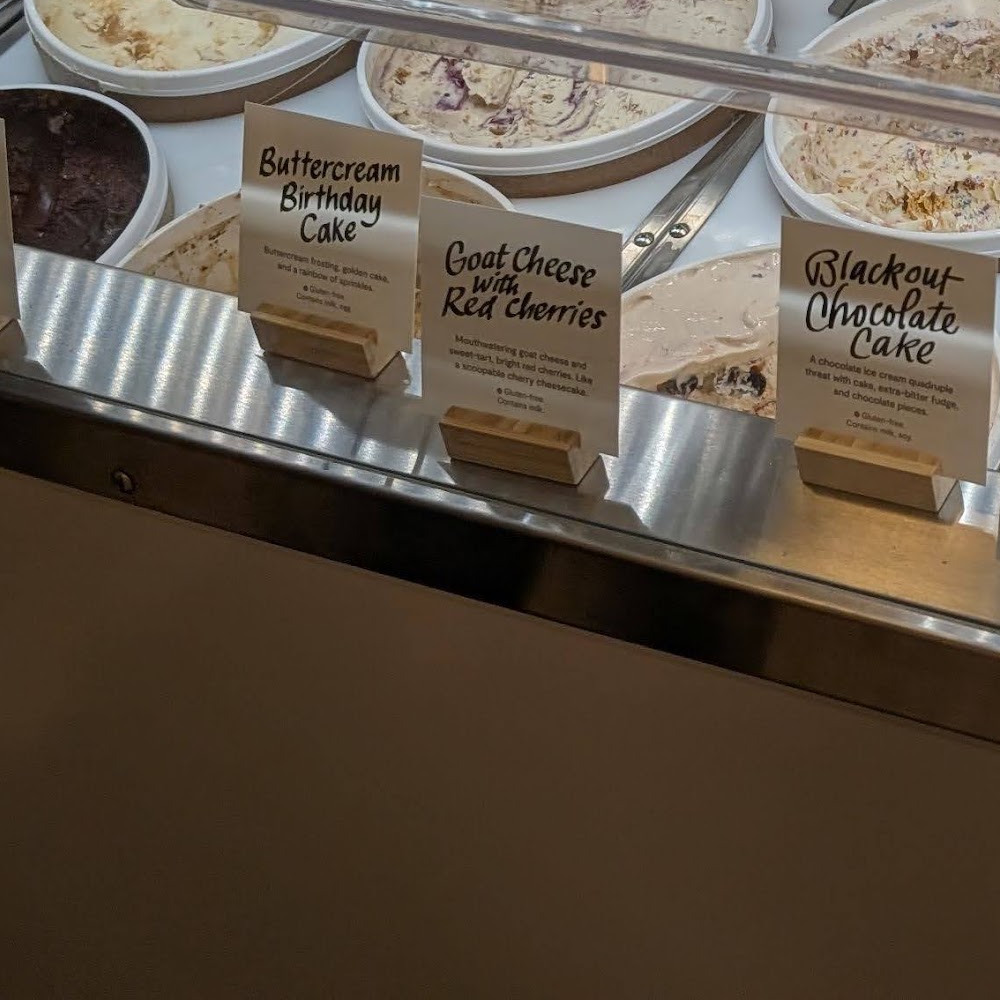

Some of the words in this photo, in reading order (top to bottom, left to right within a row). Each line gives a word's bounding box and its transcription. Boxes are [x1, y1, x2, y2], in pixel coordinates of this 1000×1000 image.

[259, 146, 400, 183] Buttercream
[280, 181, 382, 228] Birthday
[300, 213, 357, 243] Cake
[445, 240, 511, 276] Goat
[512, 244, 597, 288] Cheese
[805, 249, 965, 295] Blackout
[472, 271, 519, 296] with
[441, 286, 499, 320] Red
[805, 282, 959, 335] Chocolate
[850, 327, 936, 365] Cake
[818, 357, 862, 374] chocolate
[863, 366, 877, 377] ice
[879, 370, 907, 383] cream
[832, 375, 851, 385] with
[833, 388, 850, 399] and
[852, 391, 895, 409] chocolate
